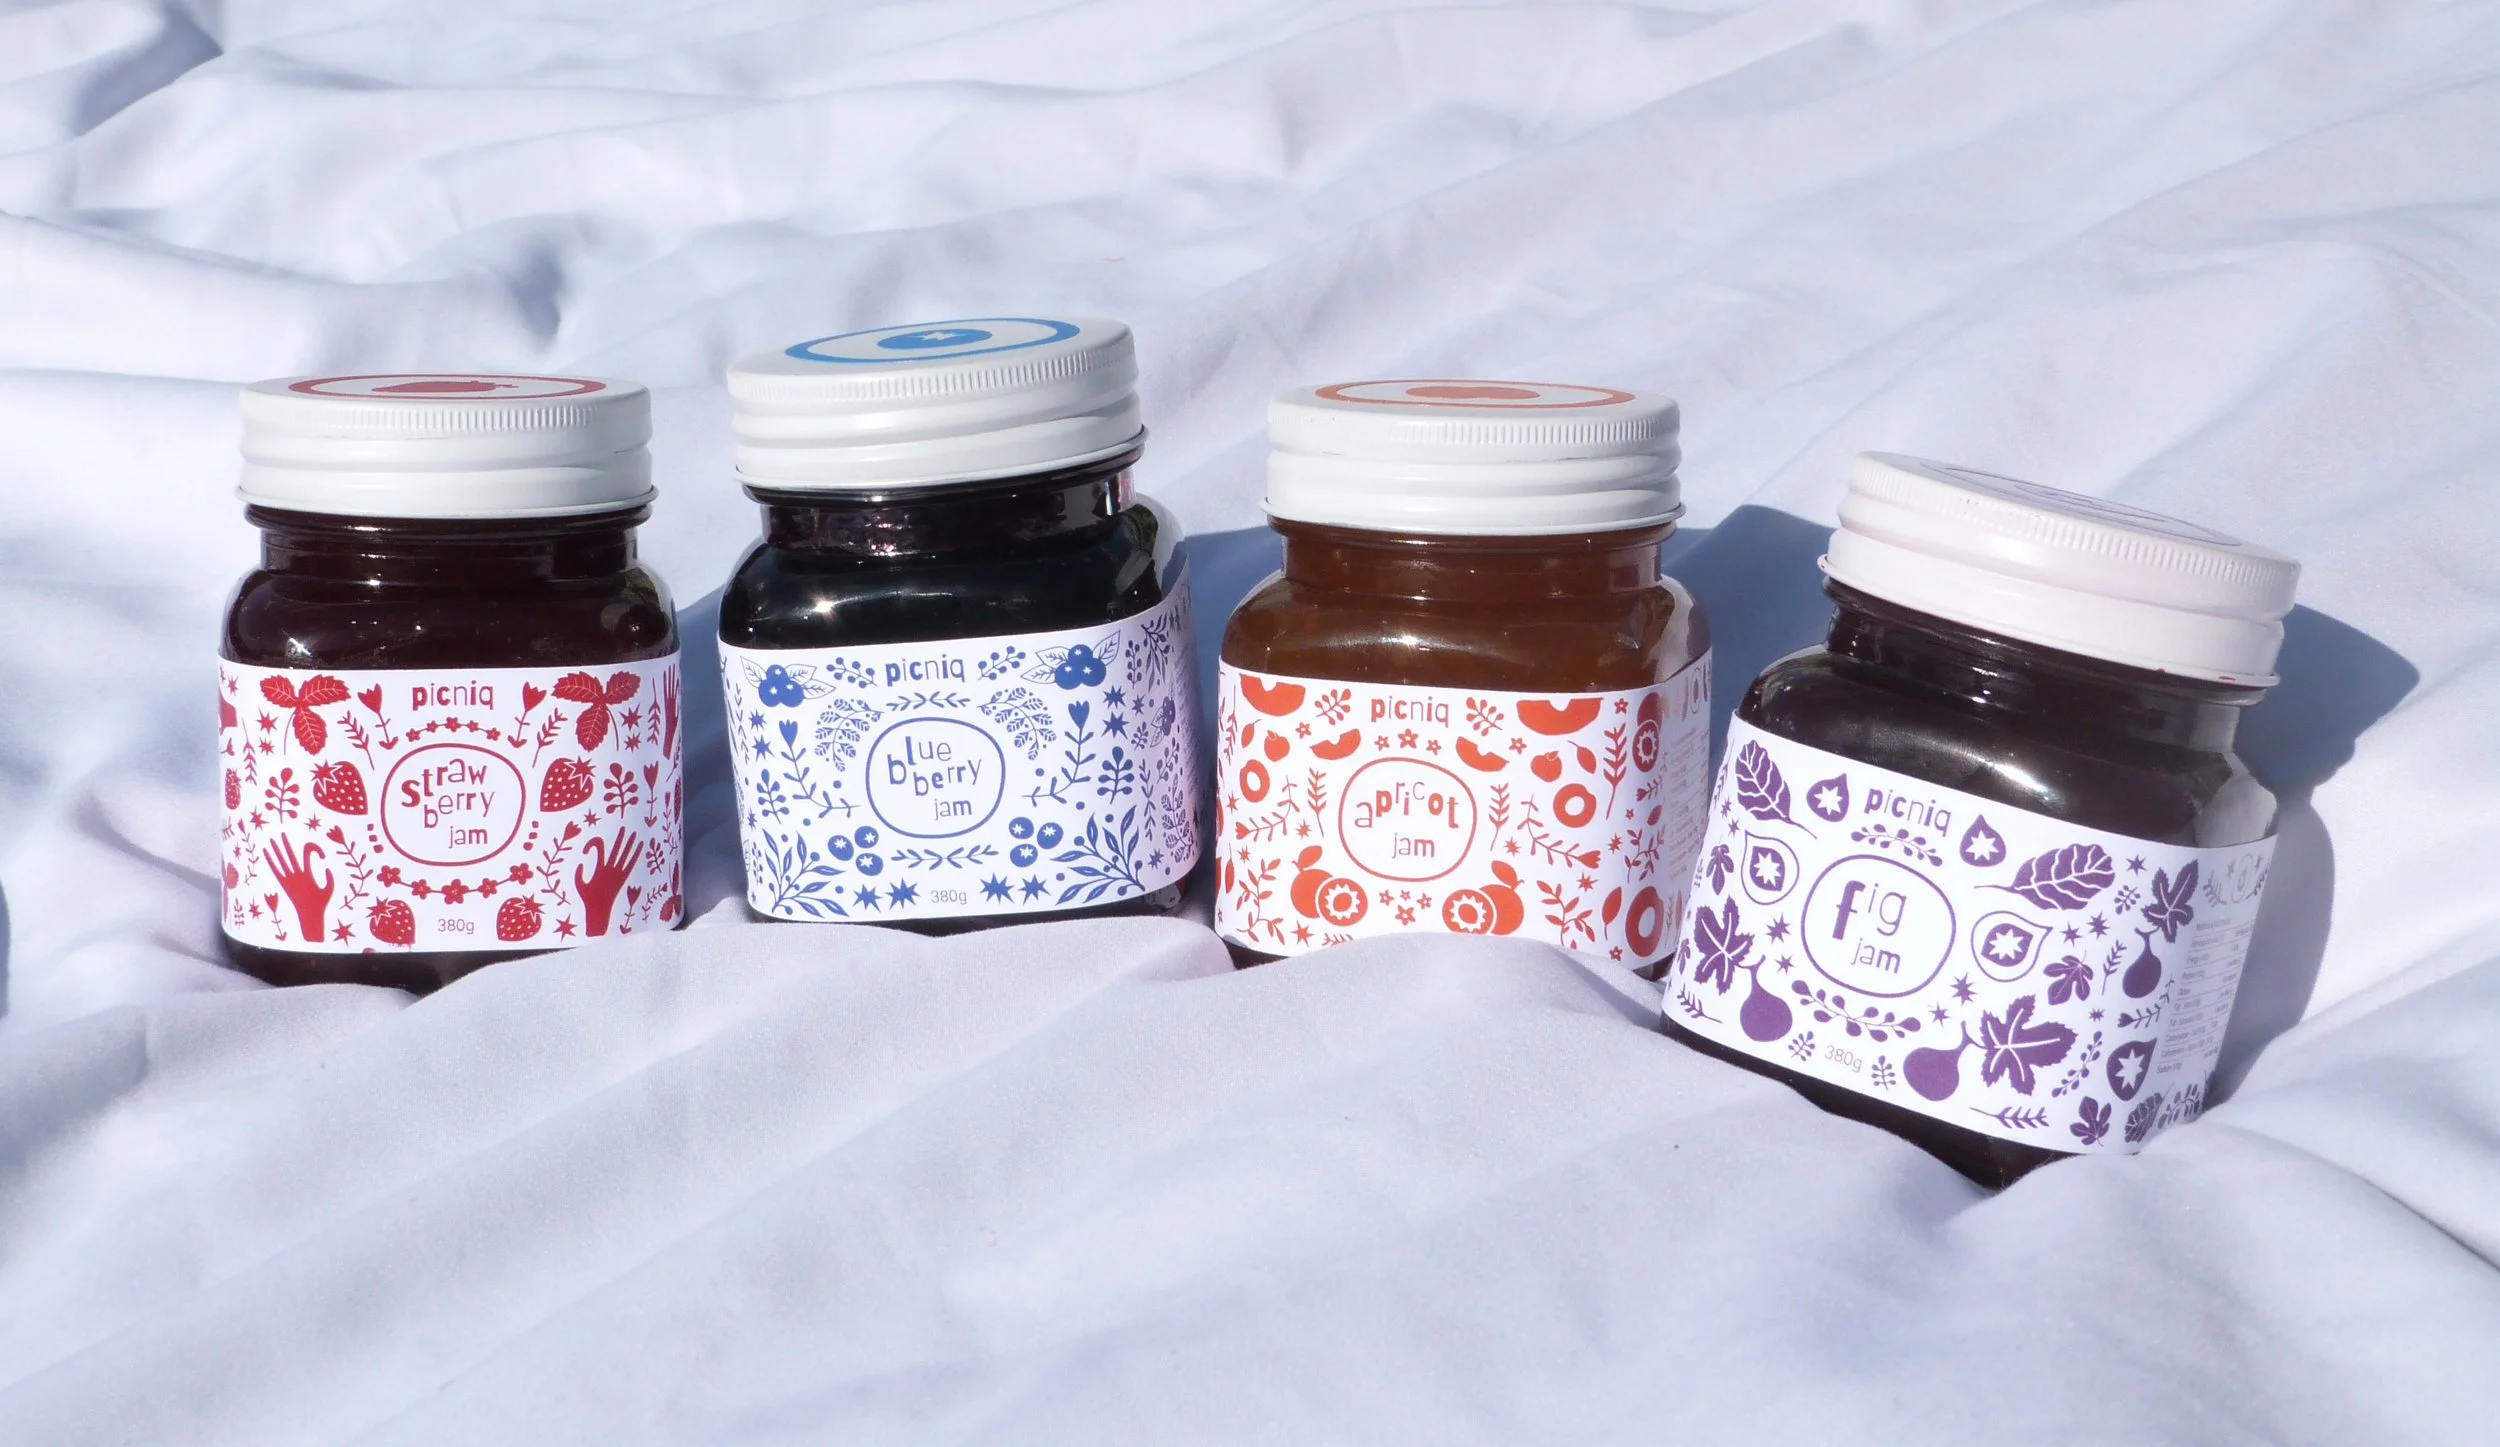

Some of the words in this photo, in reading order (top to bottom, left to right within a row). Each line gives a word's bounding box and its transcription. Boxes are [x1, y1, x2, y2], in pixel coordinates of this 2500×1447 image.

[885, 655, 966, 688] picniq
[412, 680, 494, 712] picniq
[1370, 695, 1450, 729] picniq
[886, 735, 952, 785] blue
[912, 756, 982, 797] berry
[400, 757, 488, 808] straw
[423, 791, 495, 829] berry
[933, 796, 973, 822] jam
[1354, 777, 1459, 829] apricot
[1863, 787, 1953, 838] picniq
[448, 825, 488, 849] jam
[1391, 831, 1436, 860] jam
[930, 887, 968, 906] 380g
[1832, 879, 1908, 938] fig
[437, 917, 475, 936] 380g
[1850, 937, 1902, 975] jam
[1823, 1043, 1864, 1074] 380g
